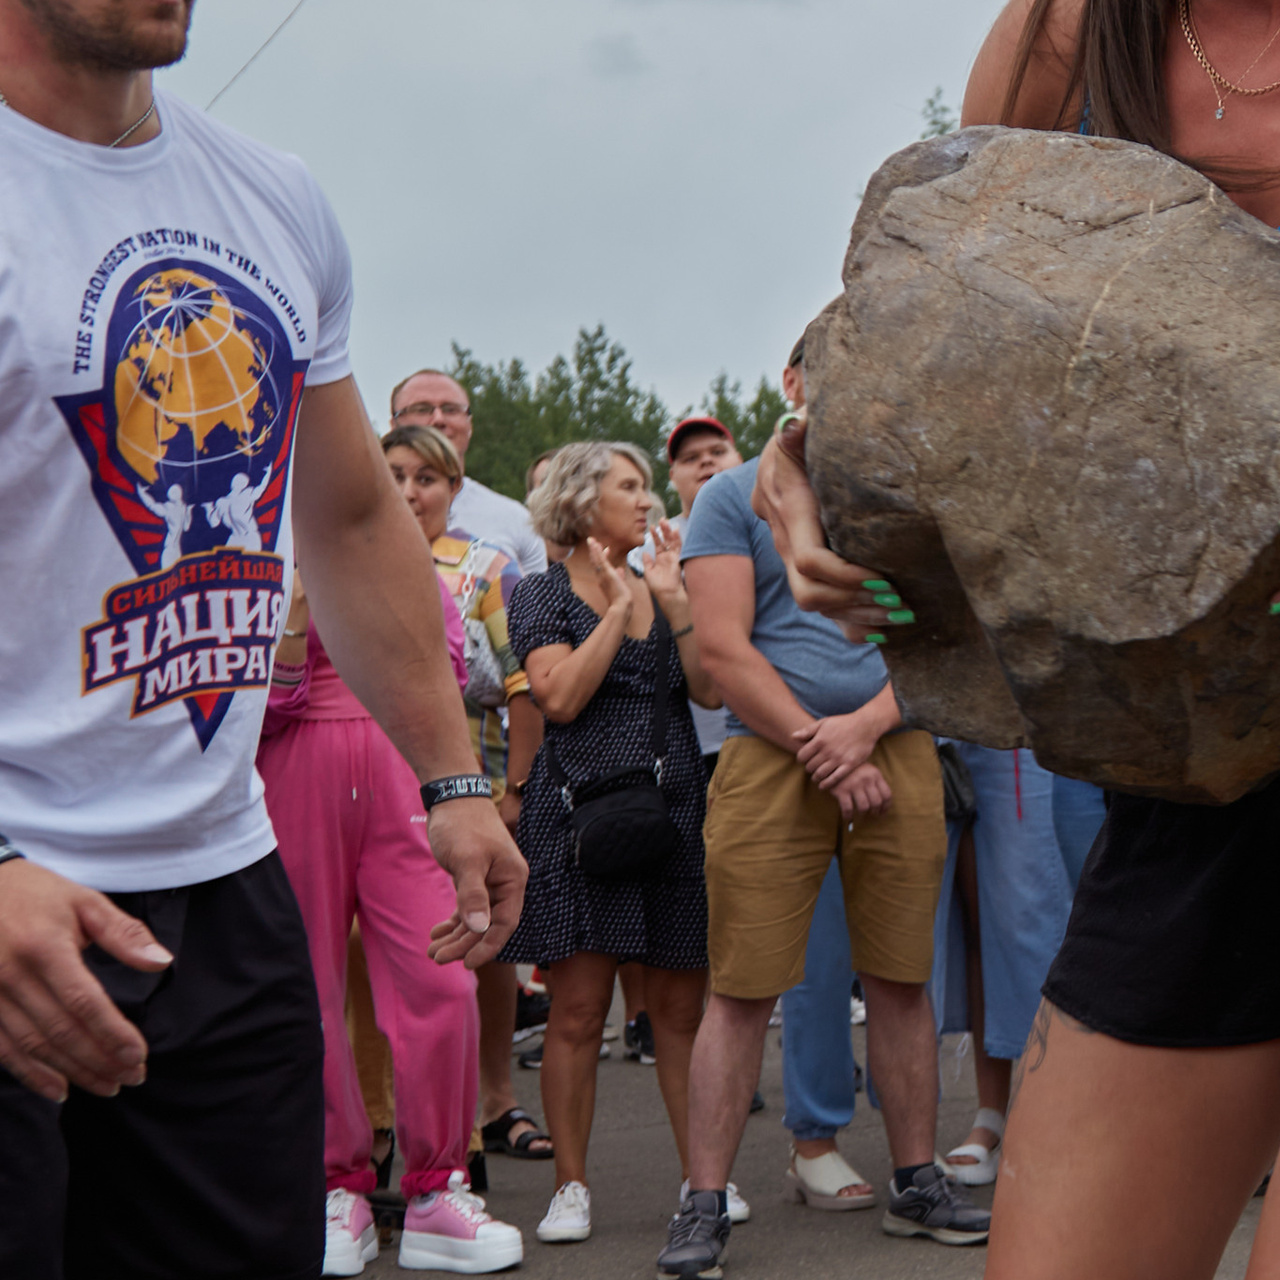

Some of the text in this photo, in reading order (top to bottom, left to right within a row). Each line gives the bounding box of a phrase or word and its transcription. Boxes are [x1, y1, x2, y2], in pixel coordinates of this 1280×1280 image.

[73, 228, 306, 375] THE STRONGEST NATION IN THE WORLD
[91, 589, 285, 683] НАЦИЯ
[140, 645, 268, 706] МИРА
